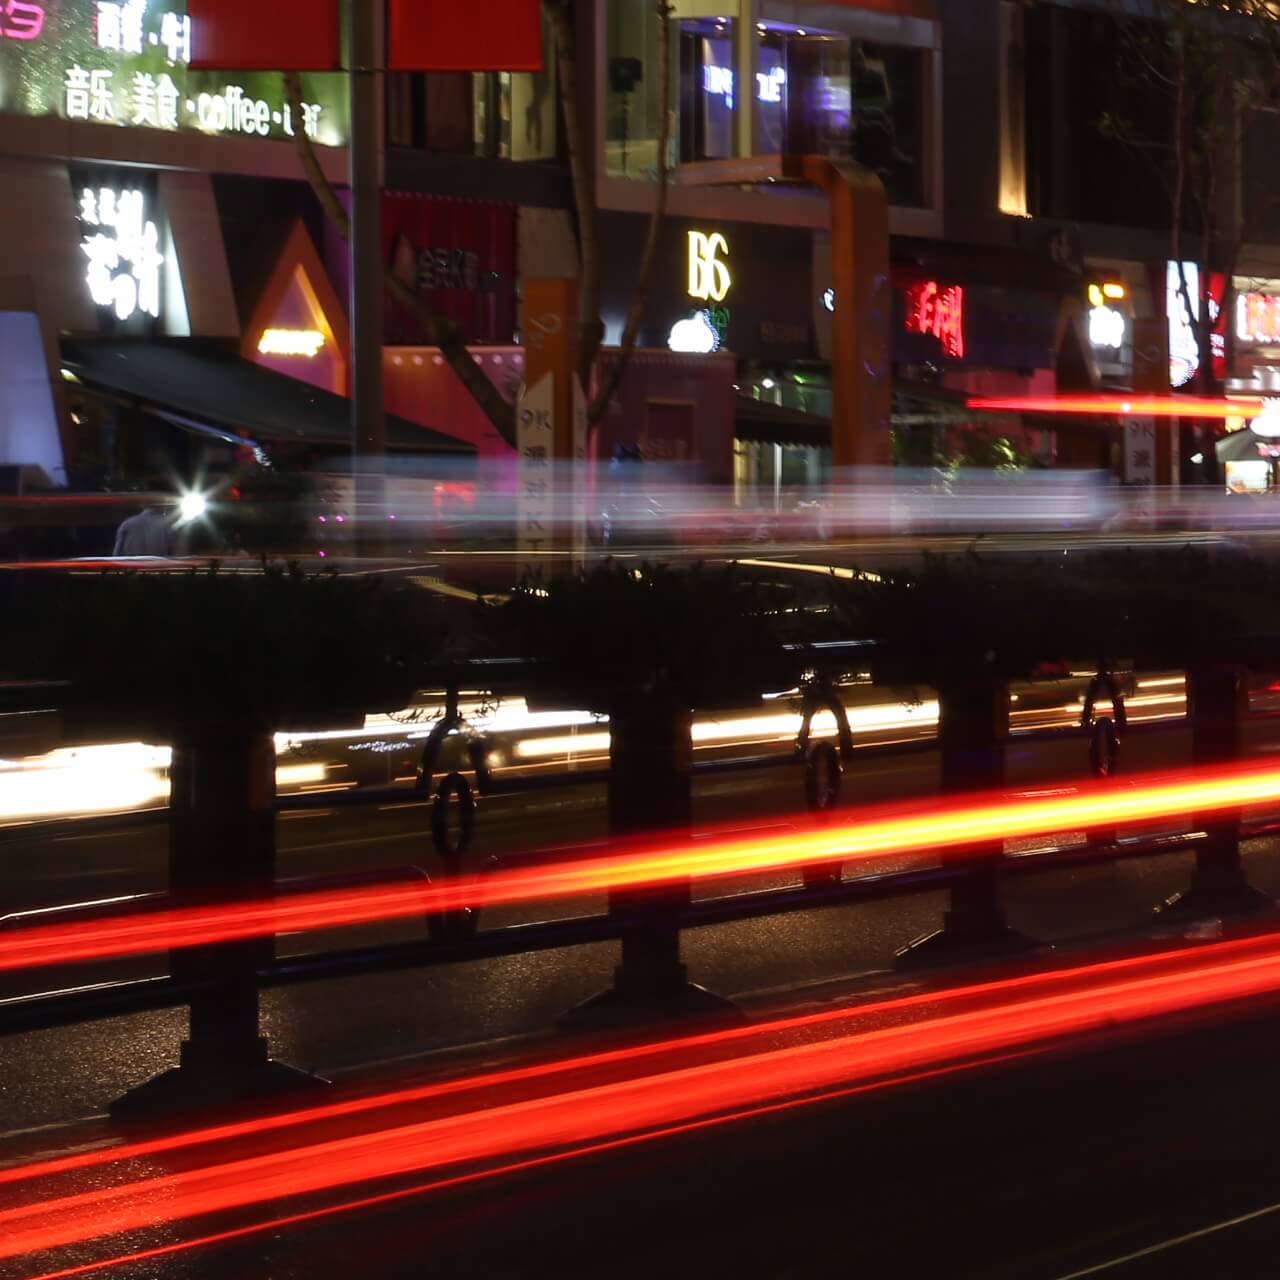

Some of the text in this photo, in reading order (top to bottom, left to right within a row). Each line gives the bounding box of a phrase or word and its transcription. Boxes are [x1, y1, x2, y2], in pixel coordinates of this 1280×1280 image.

[64, 64, 115, 121] 音乐
[132, 70, 179, 128] 美食
[198, 85, 269, 136] coffee
